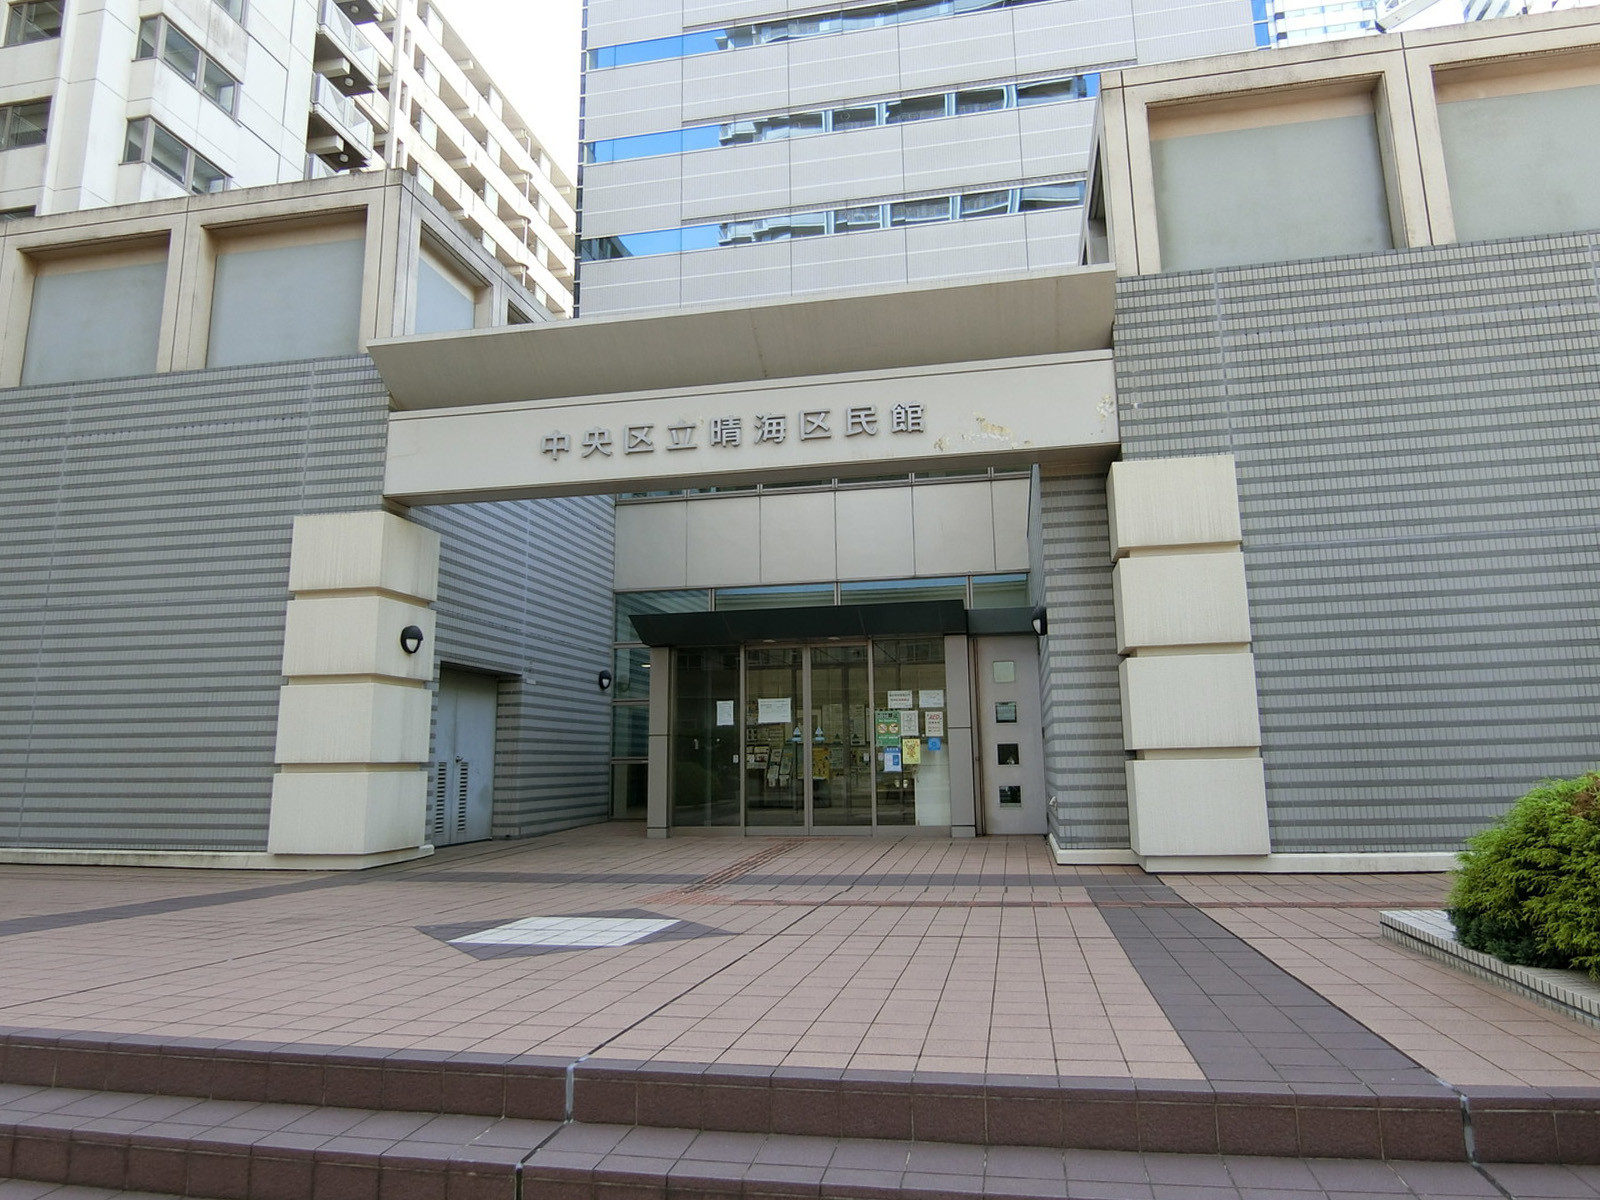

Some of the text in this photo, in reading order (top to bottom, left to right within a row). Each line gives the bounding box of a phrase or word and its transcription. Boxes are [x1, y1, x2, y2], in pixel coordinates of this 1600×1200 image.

[541, 402, 925, 461] 中央区立晴海区民館
